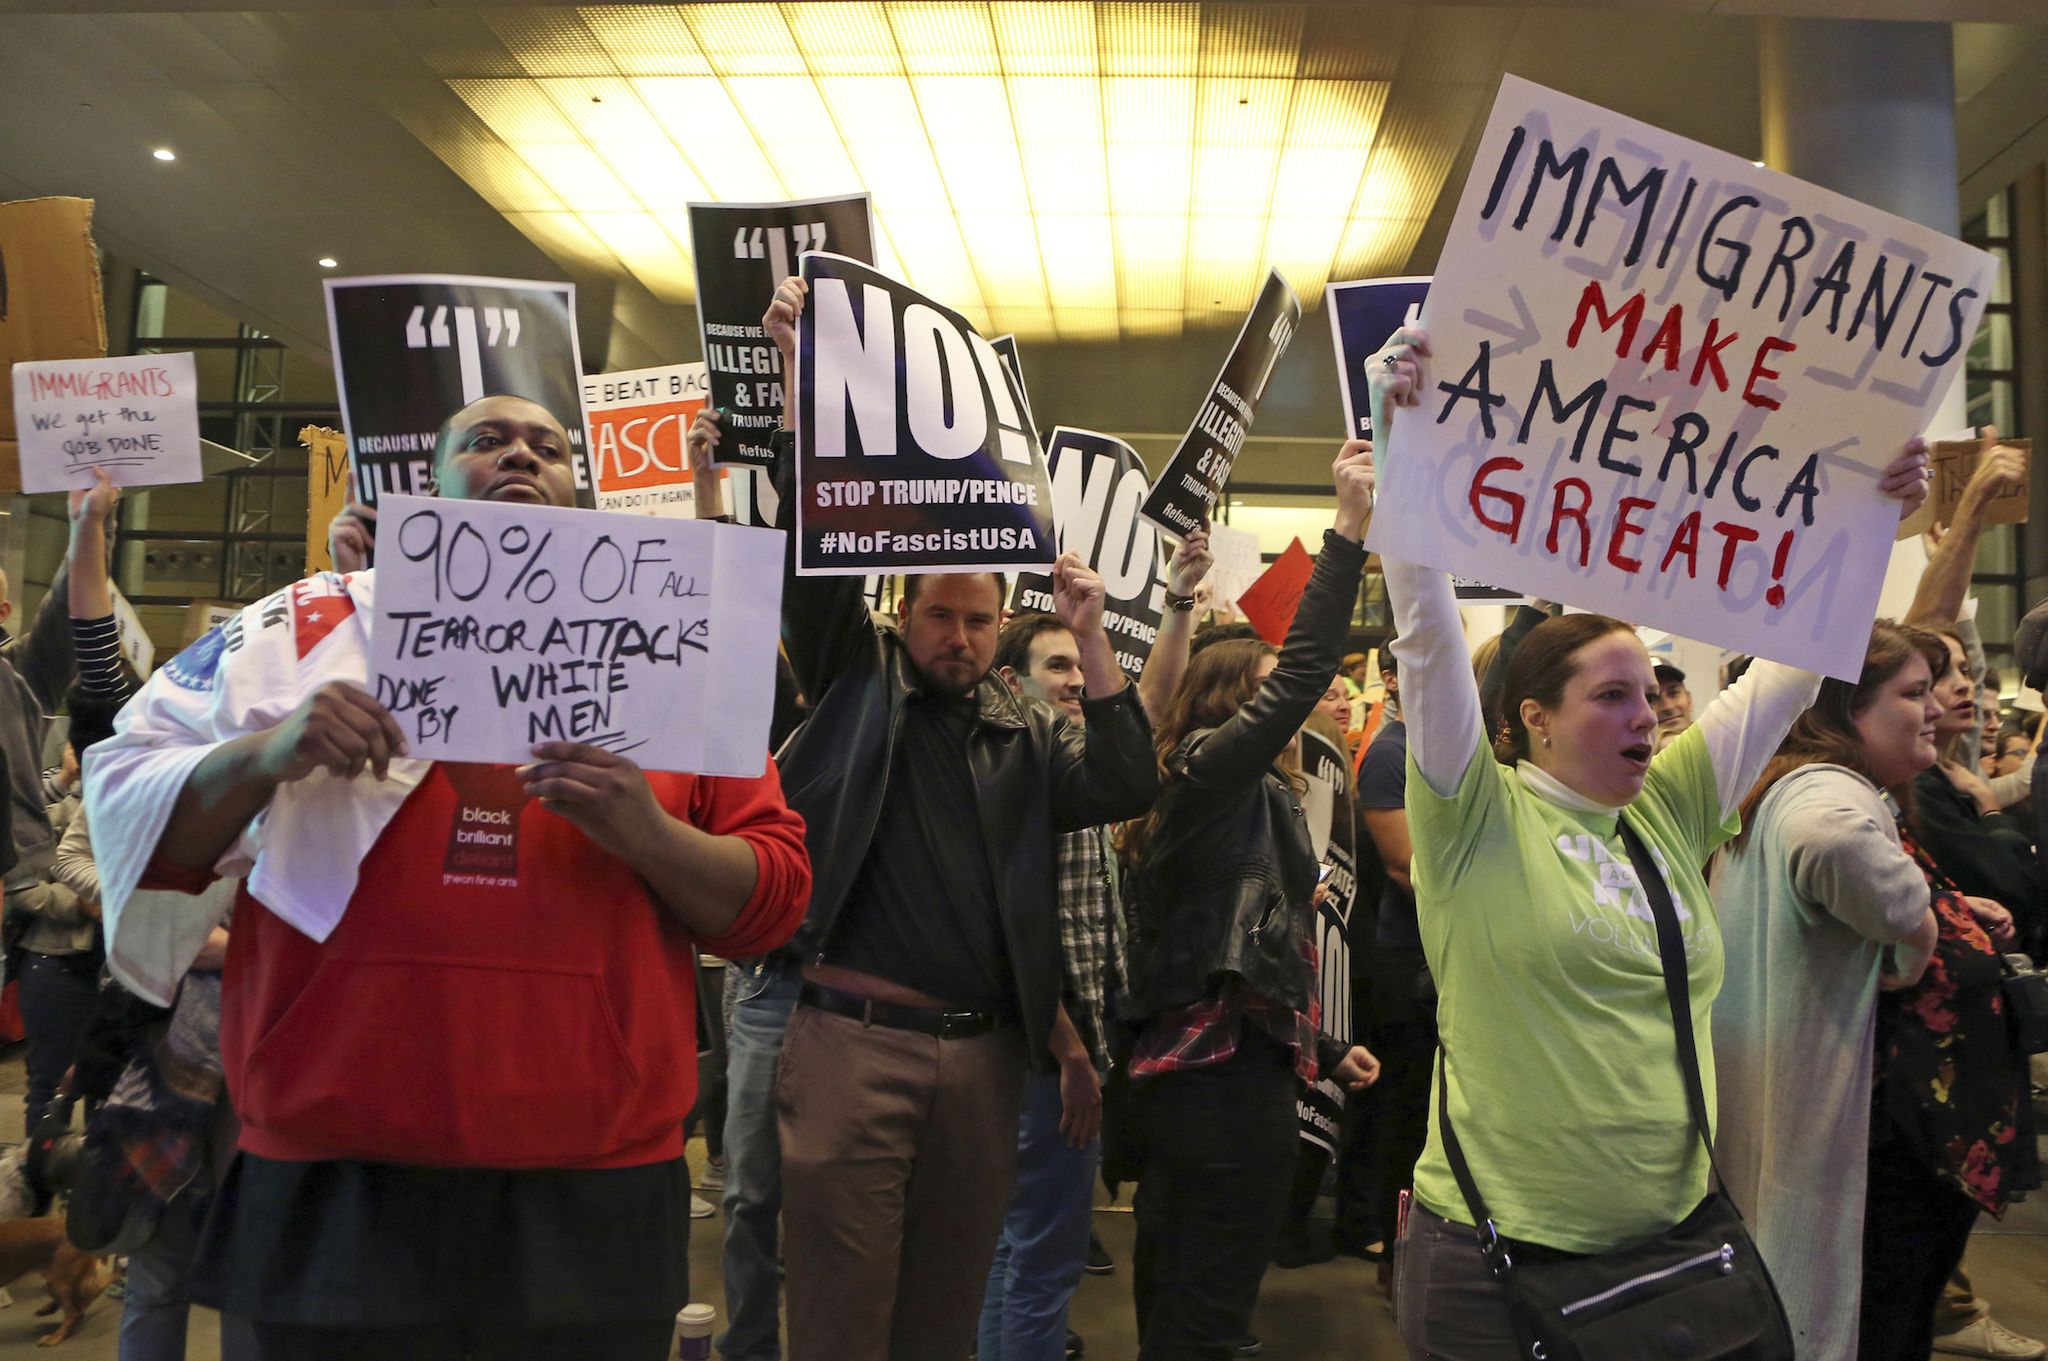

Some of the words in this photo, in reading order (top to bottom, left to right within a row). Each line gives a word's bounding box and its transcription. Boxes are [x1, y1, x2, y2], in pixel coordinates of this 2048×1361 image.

[1481, 126, 1978, 367] IMMIGRANTS
[705, 323, 744, 337] BECAUSE
[745, 326, 762, 338] WE
[1567, 280, 1797, 410] MAKE
[708, 343, 782, 375] ILLEGI
[813, 278, 1031, 465] NO!
[584, 385, 597, 403] E
[604, 378, 659, 402] BEAT
[670, 373, 708, 395] BAC
[735, 382, 753, 407] &
[756, 382, 785, 407] FA
[1216, 381, 1239, 410] BECAUSE
[77, 410, 109, 436] get
[115, 407, 157, 423] the
[731, 413, 785, 428] TRUMP-P
[1198, 401, 1246, 457] ILLEGIT
[1436, 340, 1819, 526] AMERICA
[358, 433, 418, 454] BECAUSE
[421, 432, 438, 450] W
[588, 413, 690, 480] ASCI
[738, 444, 775, 458] Refus
[1196, 447, 1213, 473] &
[1207, 455, 1231, 488] FAS
[816, 481, 875, 508] STOP
[880, 480, 1038, 506] TRUMP/PENCE
[1180, 473, 1217, 507] TRUMP-PE
[1163, 502, 1201, 533] RefuseFa
[1468, 456, 1794, 609] GREAT!
[820, 527, 1036, 554] #NoFascistUSA
[399, 510, 556, 606] 90%
[579, 534, 672, 604] OF
[659, 571, 710, 599] ALL
[387, 611, 534, 661] TERROR
[1101, 611, 1157, 646] P/PENC
[375, 674, 446, 711] DONE
[491, 661, 629, 708] WHITE
[417, 706, 460, 744] BY
[528, 698, 613, 743] MEN
[462, 807, 511, 825] black
[456, 828, 513, 846] brilliant
